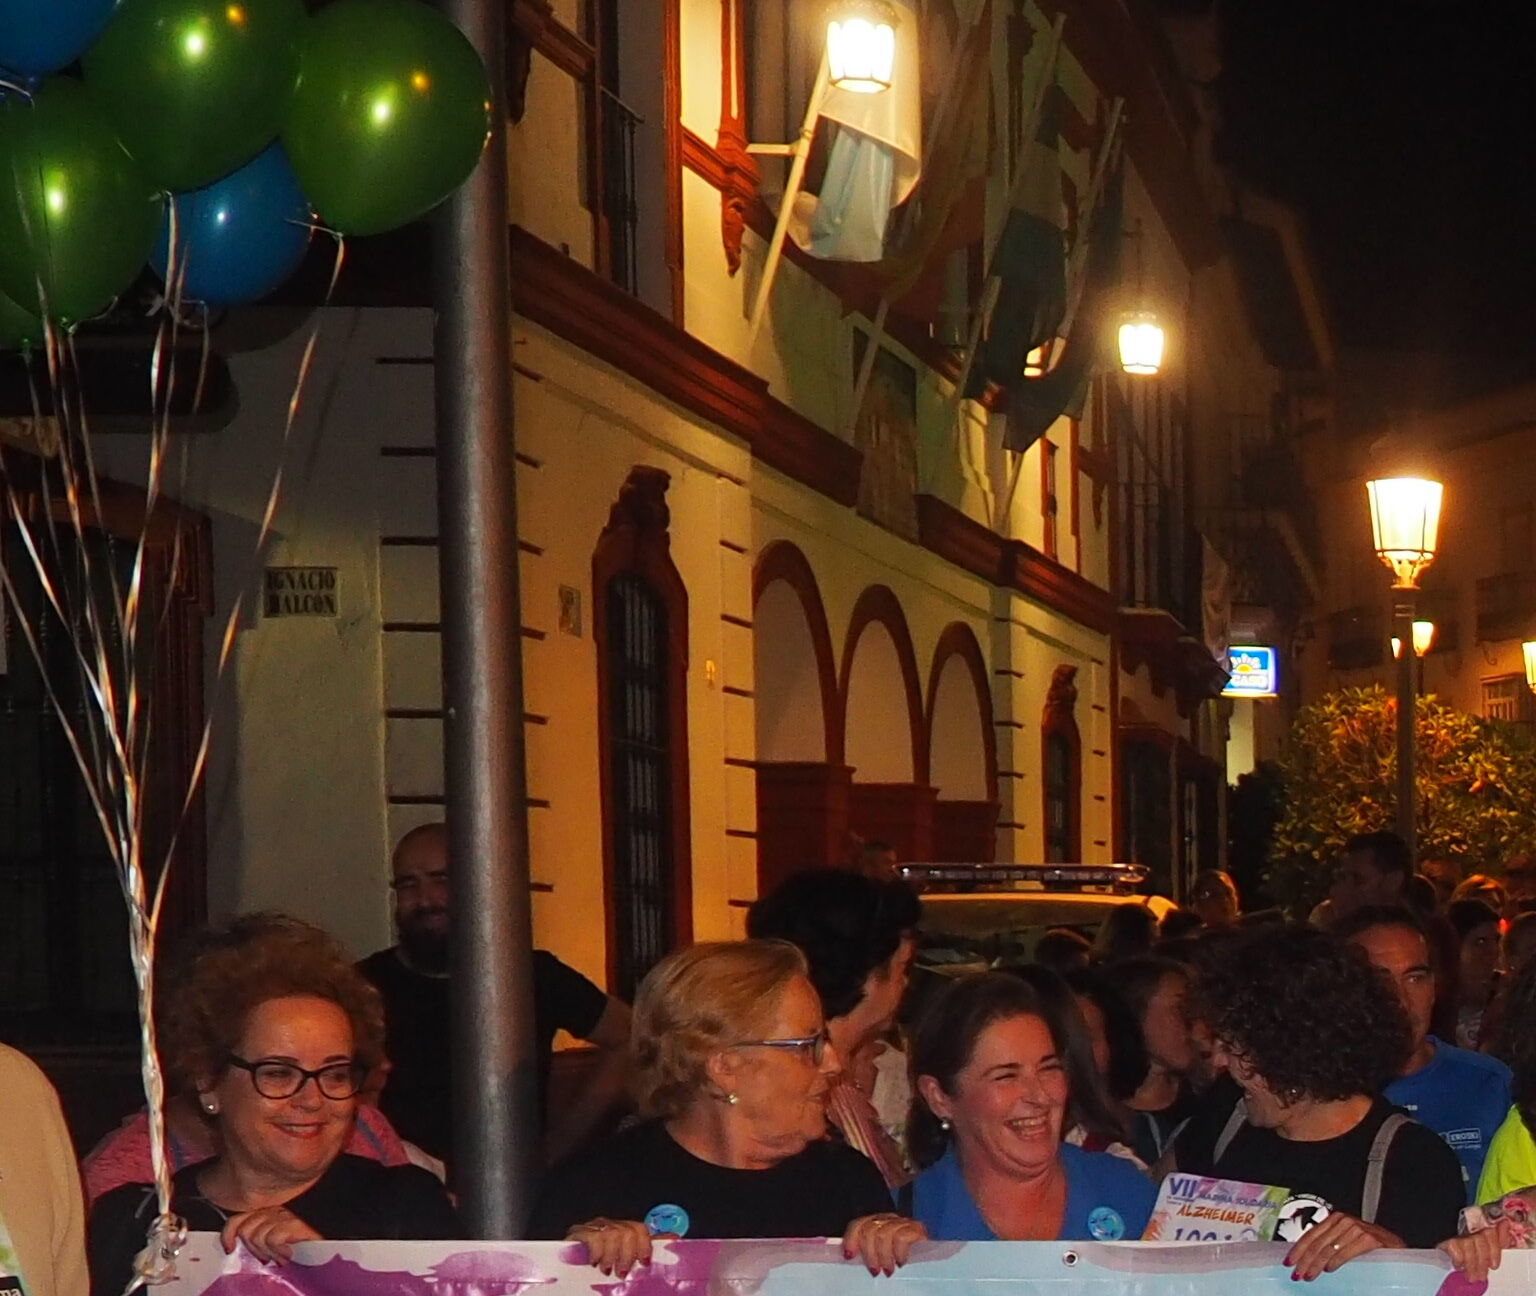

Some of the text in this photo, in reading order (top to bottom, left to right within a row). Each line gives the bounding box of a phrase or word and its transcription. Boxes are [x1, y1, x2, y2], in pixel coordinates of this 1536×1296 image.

[267, 571, 336, 590] IGNACIO
[1169, 1177, 1197, 1198] VII
[1176, 1203, 1256, 1226] ALZHEIMER
